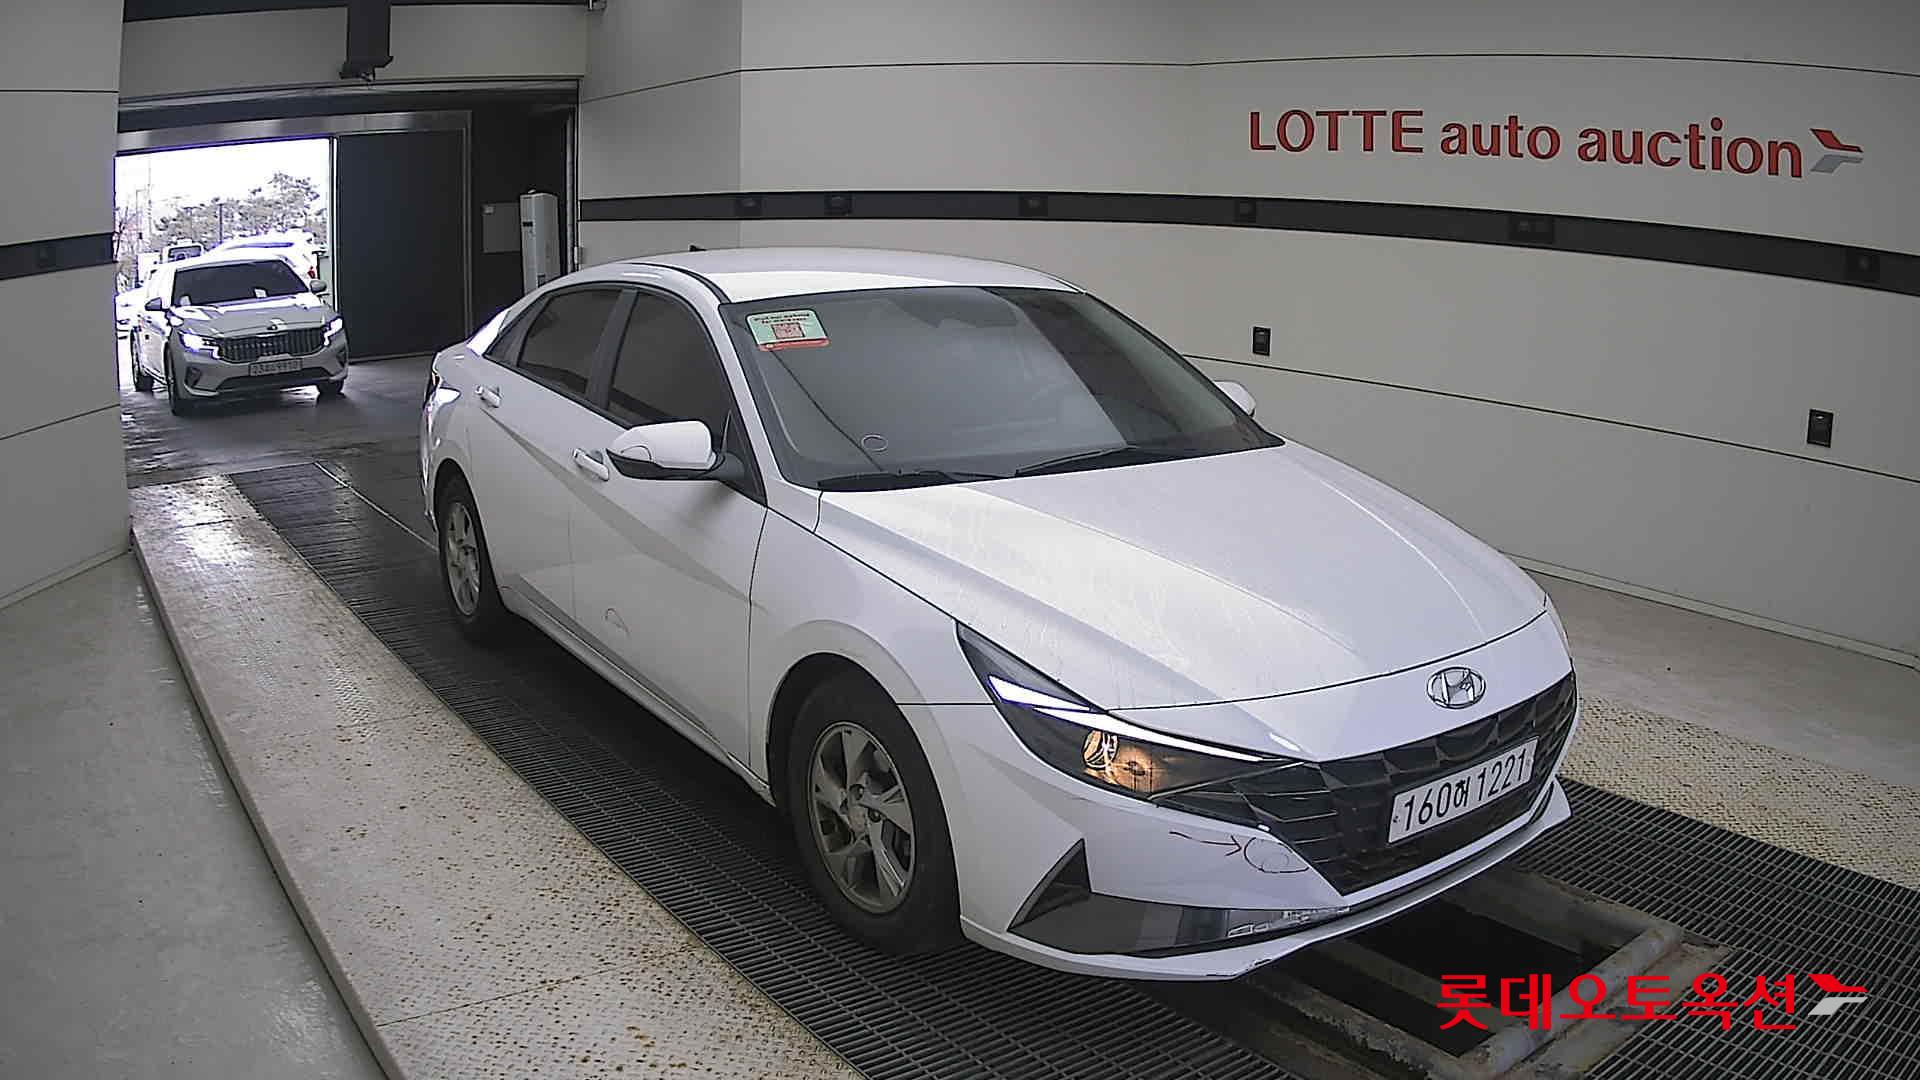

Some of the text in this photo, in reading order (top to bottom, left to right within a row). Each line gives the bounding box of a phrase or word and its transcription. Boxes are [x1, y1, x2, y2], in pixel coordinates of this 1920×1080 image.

[1249, 109, 1804, 178] LOTTE auto auction
[1404, 748, 1527, 831] 160허 1221
